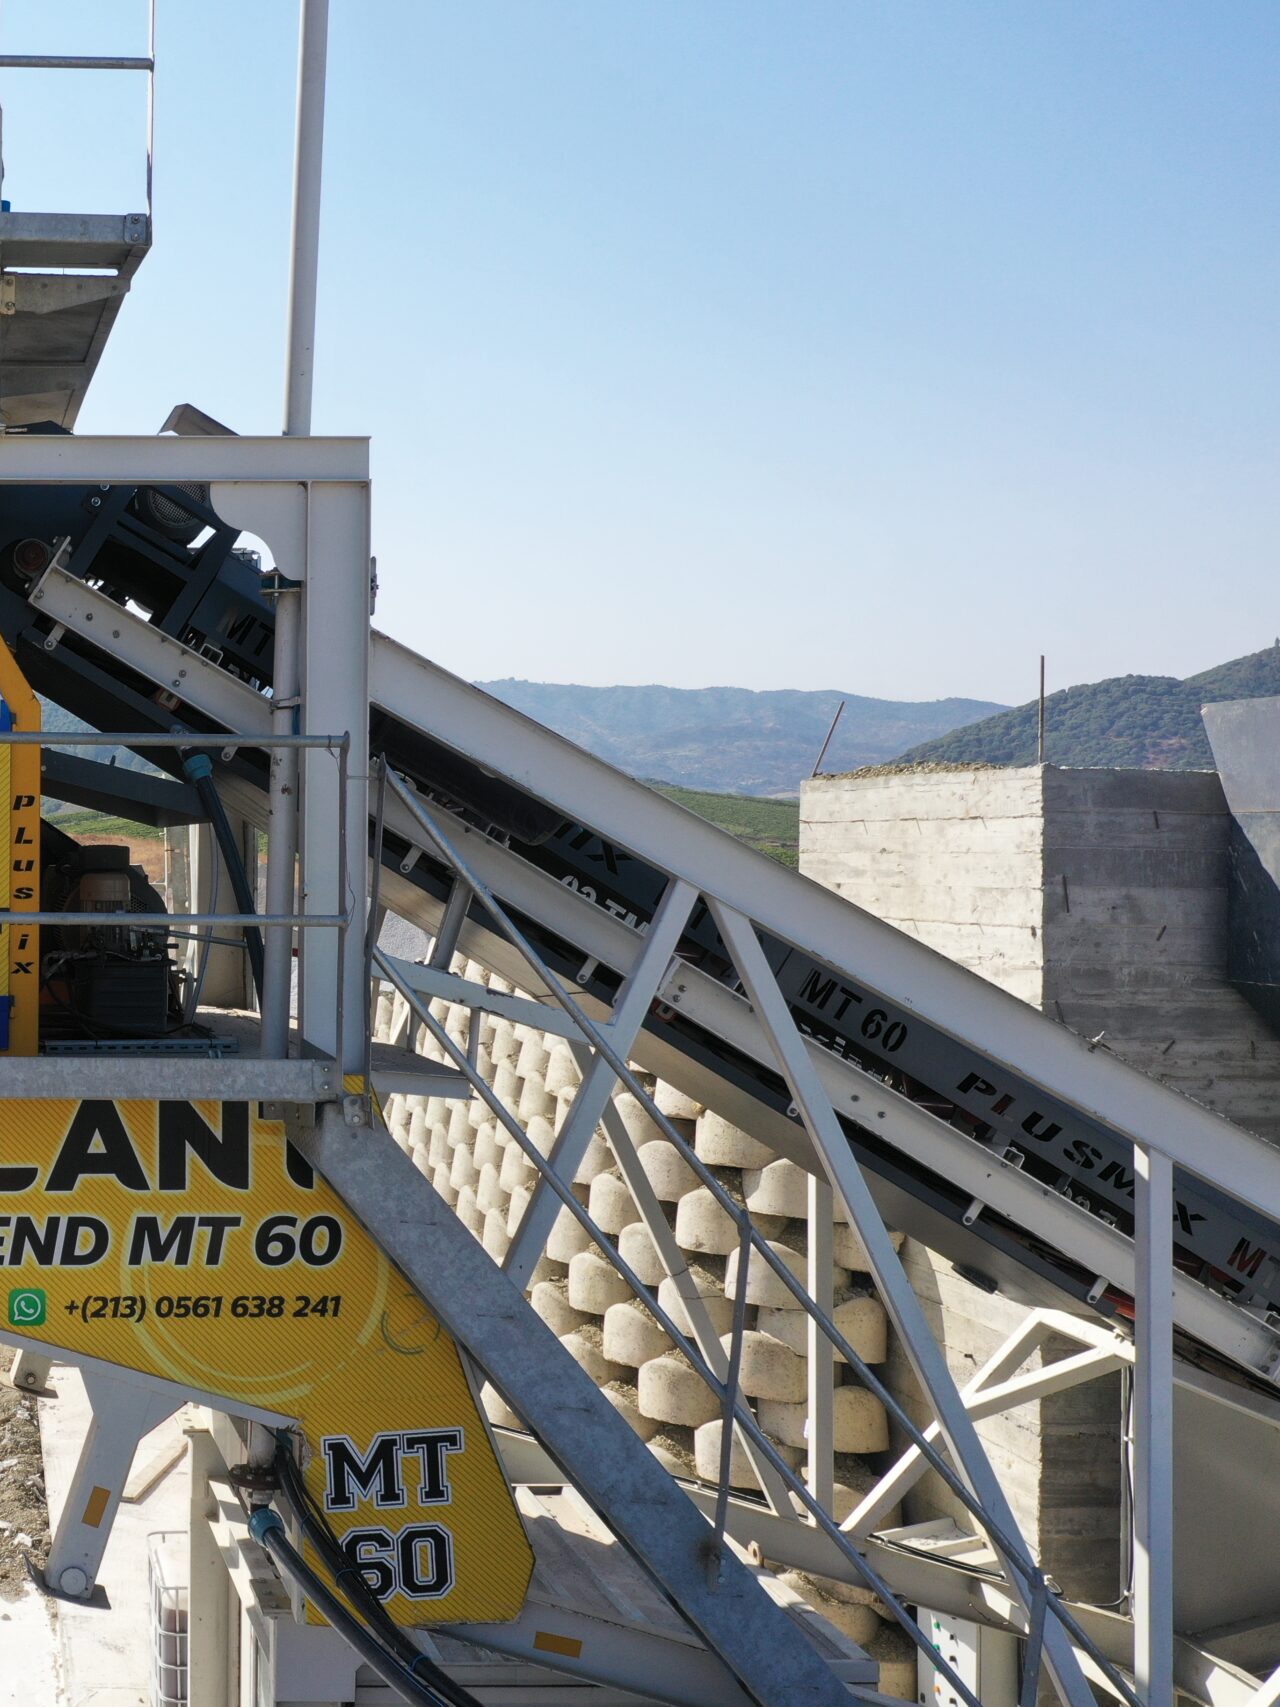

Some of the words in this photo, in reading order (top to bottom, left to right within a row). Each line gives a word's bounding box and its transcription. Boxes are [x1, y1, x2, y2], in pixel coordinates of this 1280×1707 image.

[798, 967, 863, 1023] MT
[861, 1008, 909, 1053] 60
[128, 1215, 241, 1267] MT
[254, 1213, 343, 1267] 60
[63, 1296, 146, 1323] +(213)
[155, 1296, 228, 1319] 0561
[232, 1295, 285, 1319] 638
[293, 1295, 341, 1319] 241
[323, 1427, 465, 1513] MT
[340, 1522, 456, 1604] 60
